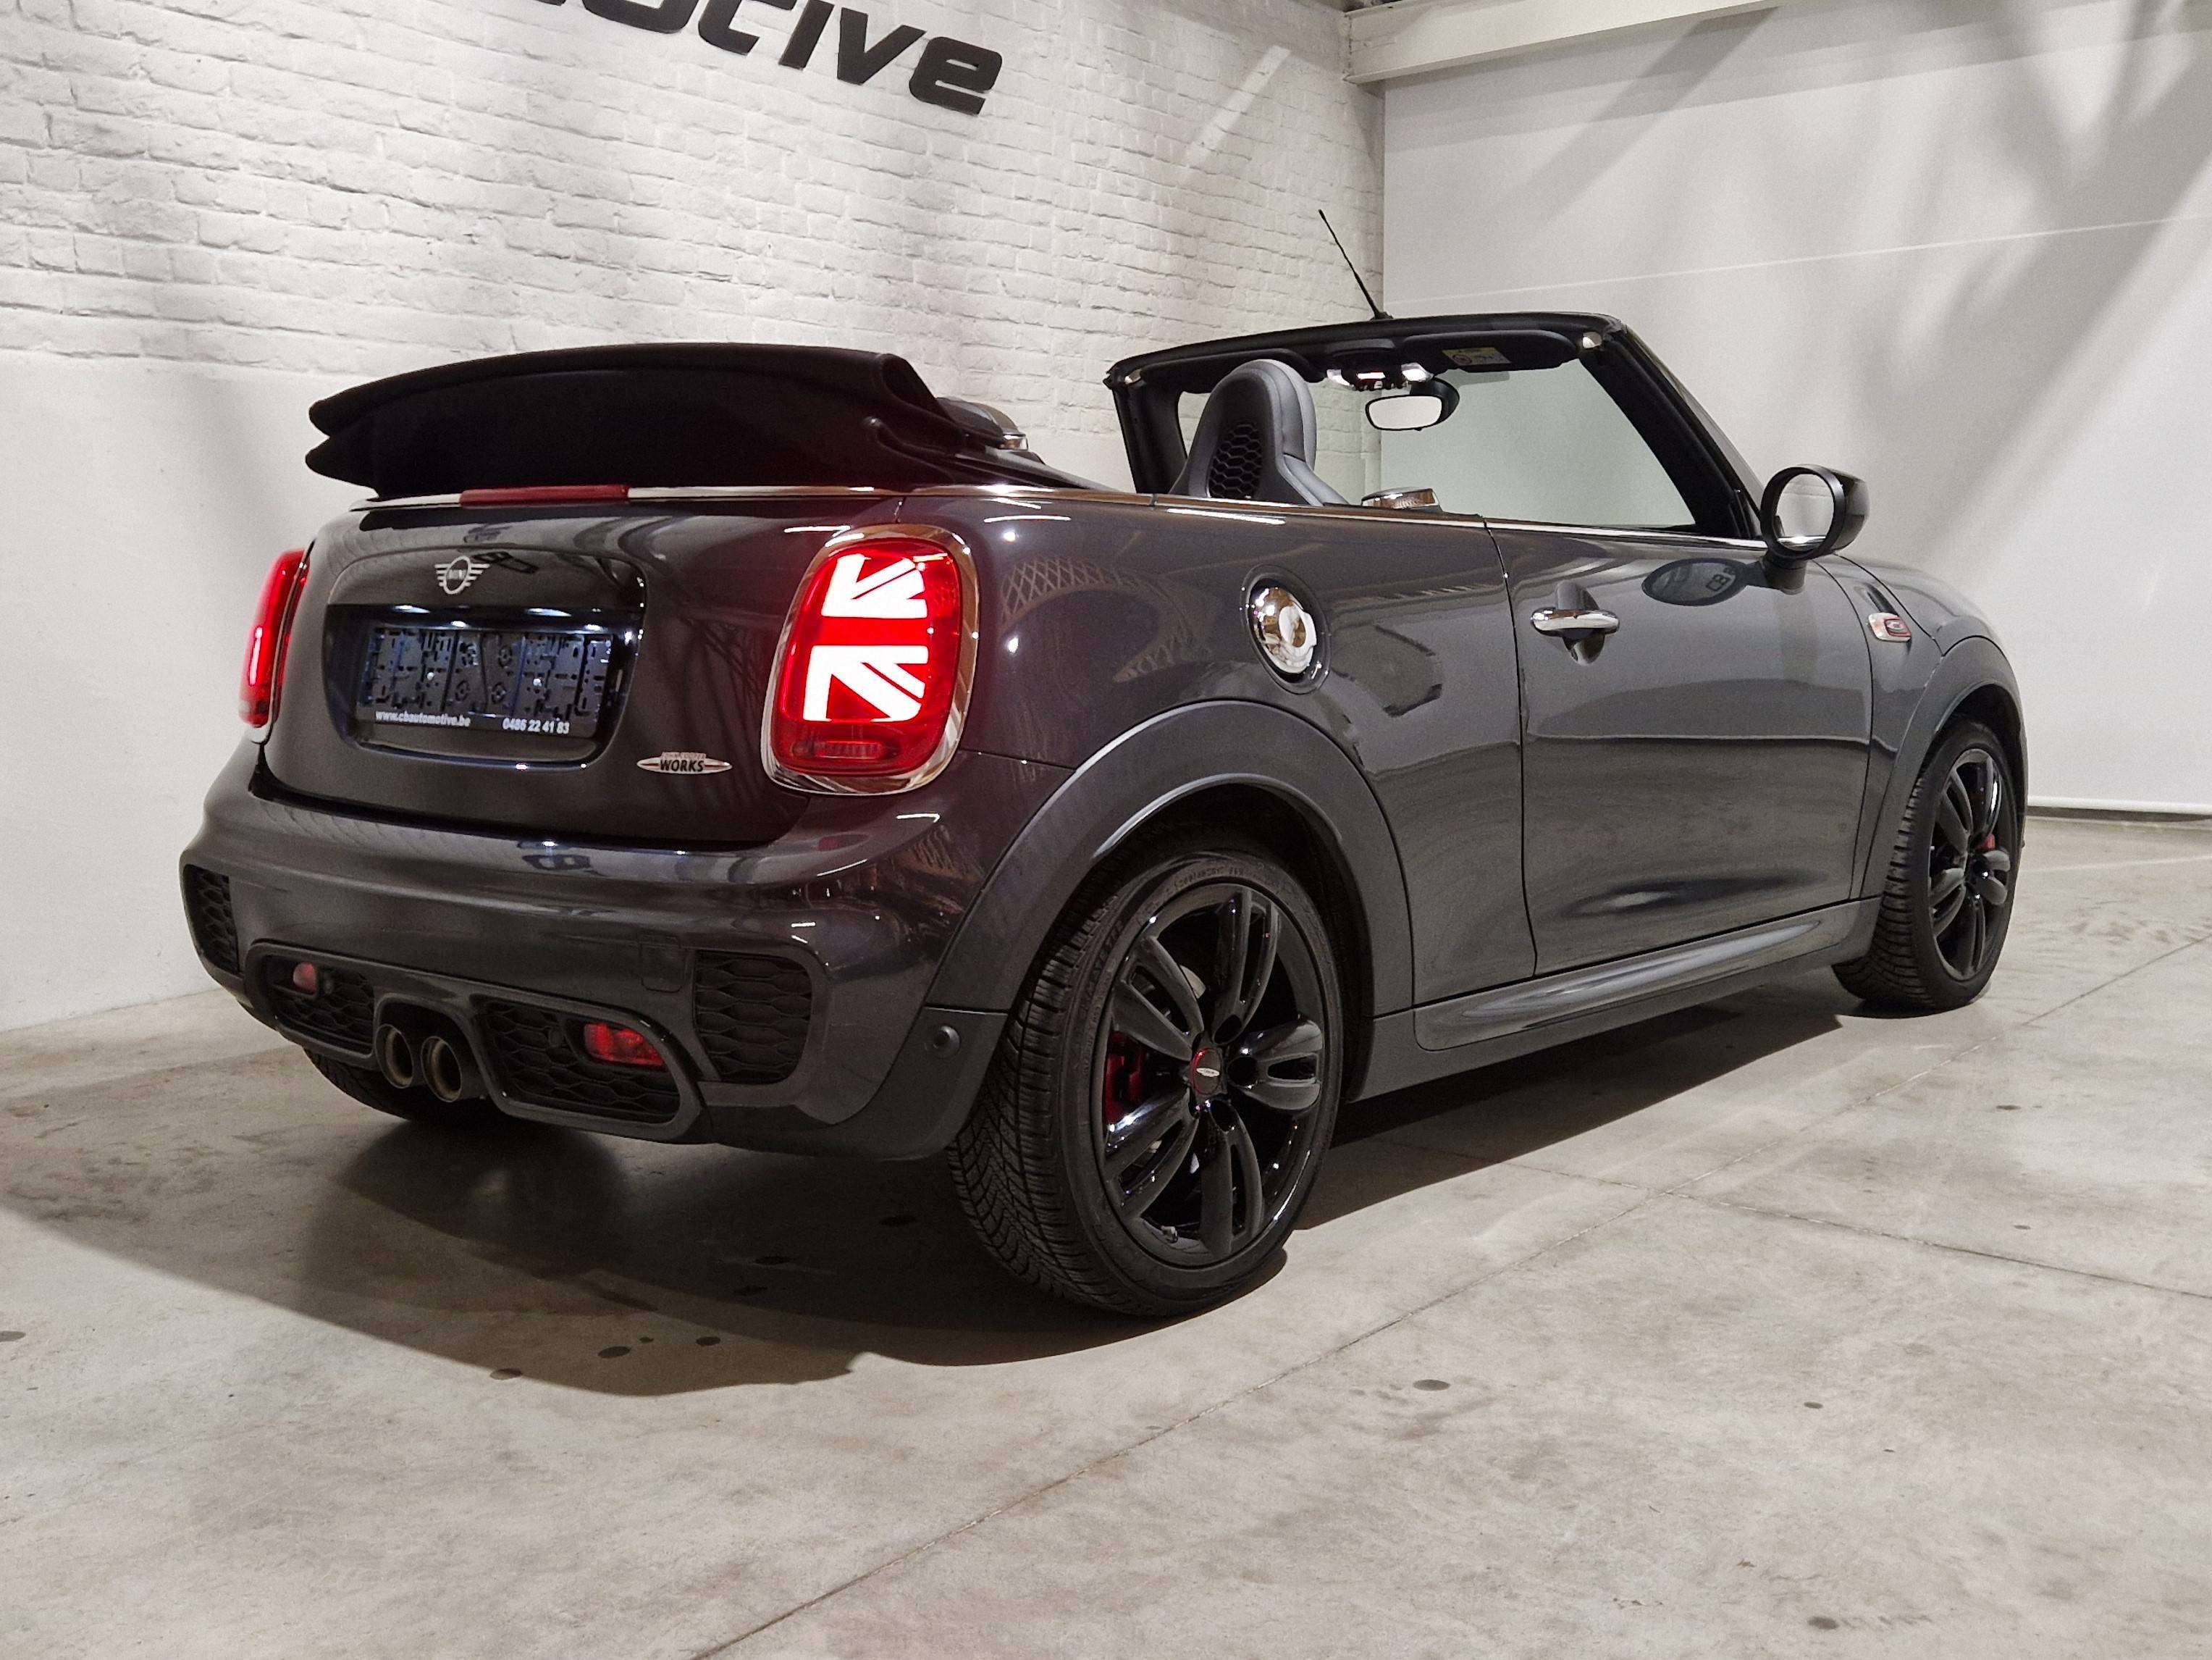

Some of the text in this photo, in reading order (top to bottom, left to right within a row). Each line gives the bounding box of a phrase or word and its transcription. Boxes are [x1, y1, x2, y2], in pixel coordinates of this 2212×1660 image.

[527, 718, 541, 732] 22
[542, 720, 555, 733] 41
[660, 759, 705, 772] WORKS
